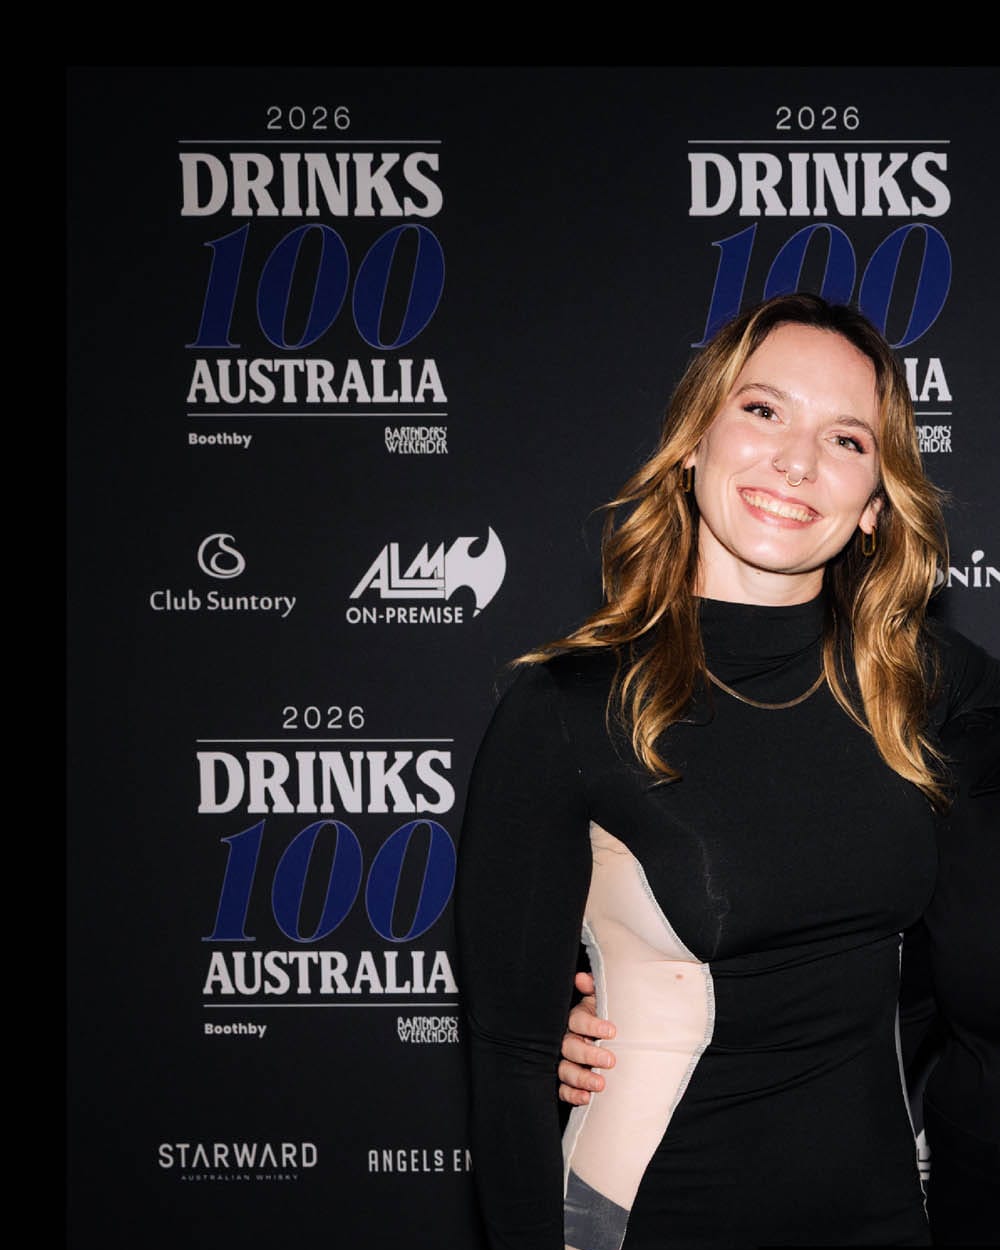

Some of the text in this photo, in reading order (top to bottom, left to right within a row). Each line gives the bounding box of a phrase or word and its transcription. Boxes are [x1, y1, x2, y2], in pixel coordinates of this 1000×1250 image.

[267, 106, 350, 129] 2026
[776, 107, 859, 130] 2026
[179, 152, 443, 217] DRINKS
[688, 152, 951, 217] DRINKS
[184, 222, 446, 350] 100
[187, 359, 447, 403] AUSTRALIA
[189, 433, 251, 448] Boothby
[385, 439, 448, 453] WEEKENDER
[920, 439, 952, 453] ENDER
[150, 590, 296, 617] Club Suntory
[346, 607, 463, 623] ON-PREMISE
[283, 706, 364, 729] 2026
[197, 750, 455, 814] DRINKS
[201, 816, 457, 943] 100
[203, 951, 458, 995] AUSTRALIA
[205, 1023, 266, 1038] Boothby
[398, 1031, 459, 1043] WEEKENDER
[159, 1143, 317, 1168] STARWARD
[369, 1150, 444, 1172] ANGELS
